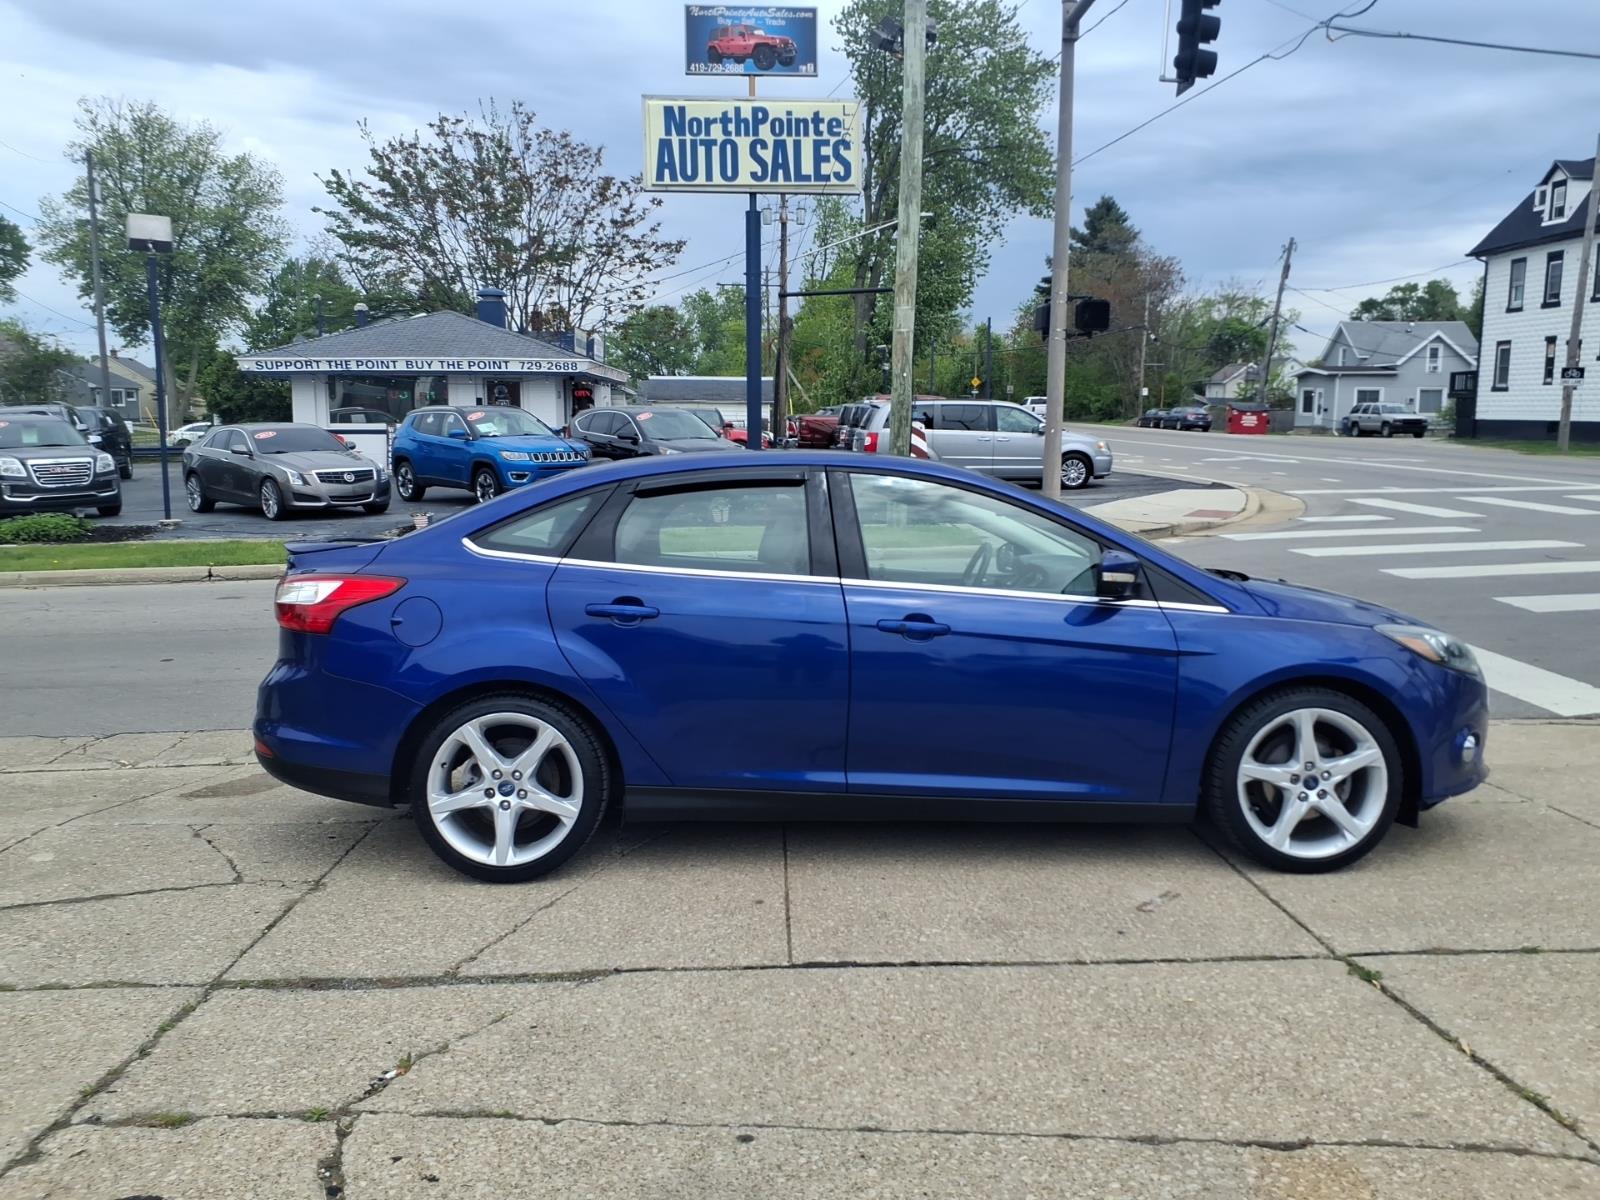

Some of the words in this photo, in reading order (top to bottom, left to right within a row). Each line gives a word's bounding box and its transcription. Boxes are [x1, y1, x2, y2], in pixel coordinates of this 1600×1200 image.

[689, 6, 814, 18] NorthPointeAutoSales.com
[690, 63, 744, 73] 419-729-2688
[663, 105, 842, 137] NorthPointe
[655, 138, 739, 182] AUTO
[750, 138, 852, 182] SALES
[255, 360, 321, 370] SUPPORT
[326, 360, 352, 370] THE
[356, 360, 398, 370] POINT
[405, 360, 433, 370] BUY
[438, 360, 464, 370] THE
[468, 360, 511, 370] POINT
[519, 361, 578, 371] 729-2688
